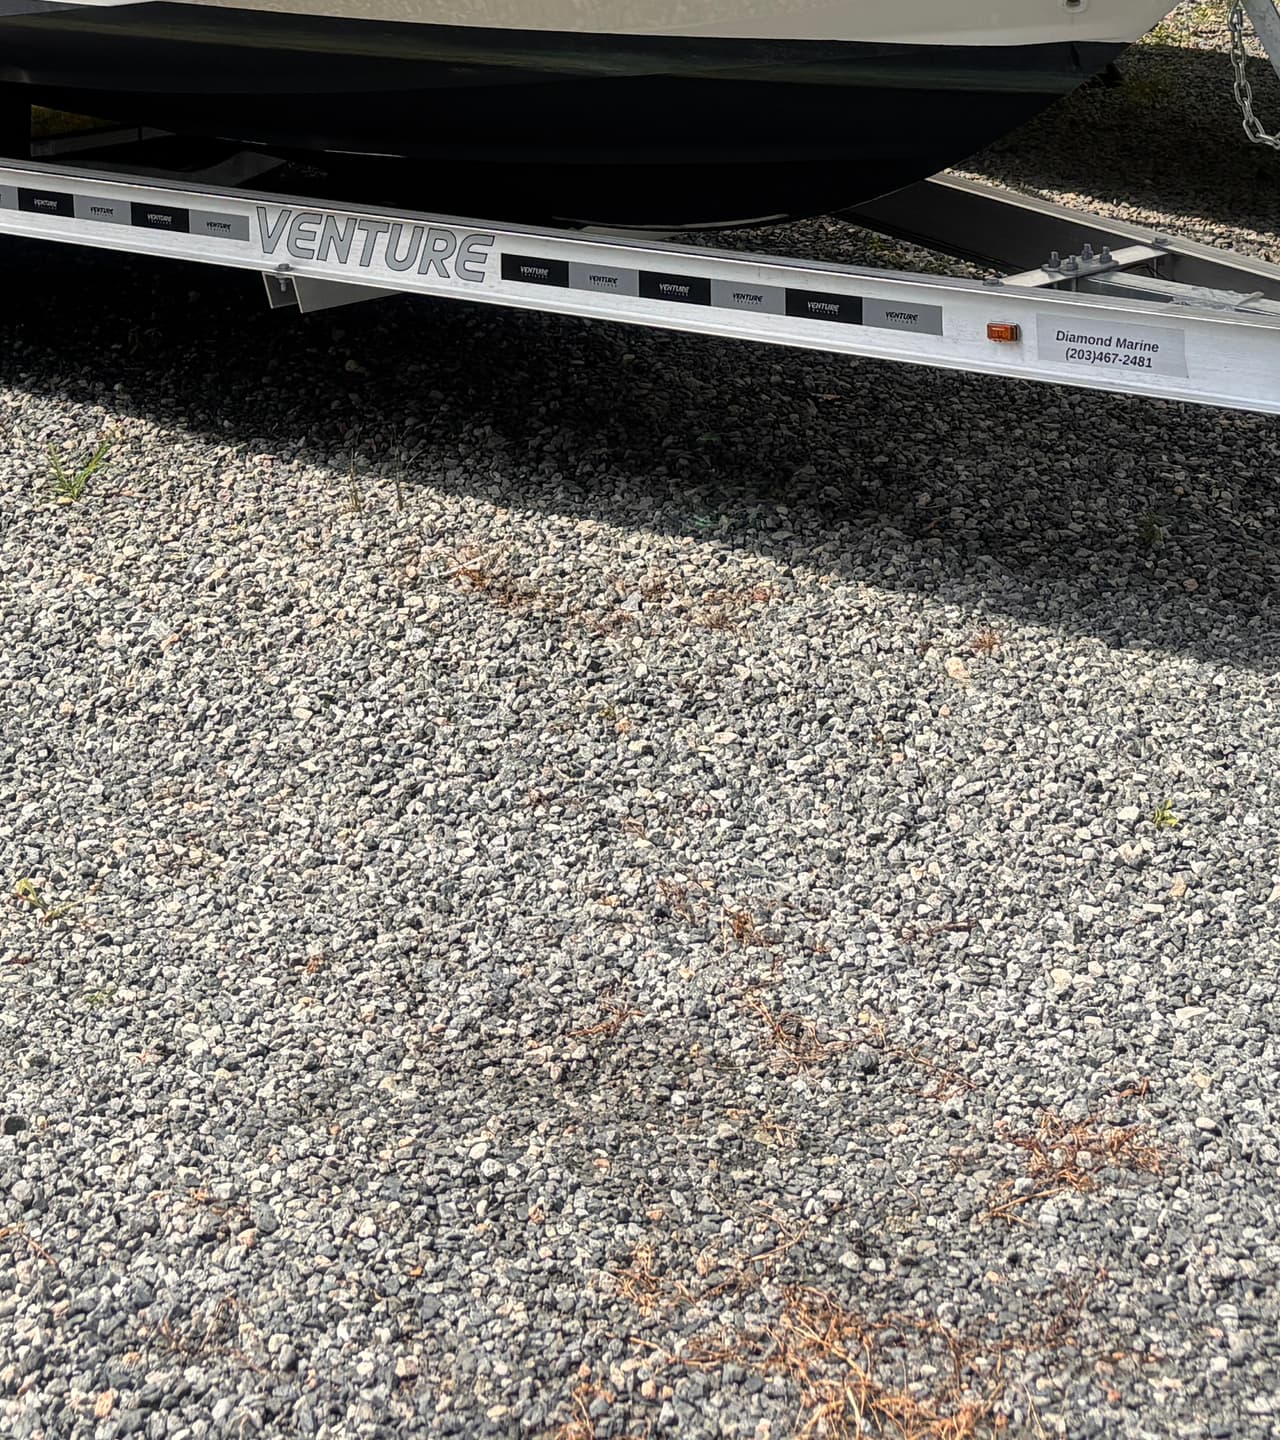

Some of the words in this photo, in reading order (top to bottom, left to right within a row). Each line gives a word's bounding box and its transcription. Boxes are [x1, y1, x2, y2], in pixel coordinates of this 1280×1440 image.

[256, 206, 496, 283] VENTURE
[659, 283, 691, 294] VENTURE
[732, 293, 764, 303] VENTURE
[807, 301, 840, 312] VENTURE
[1055, 330, 1113, 347] Diamond
[1115, 337, 1160, 353] Marine
[1065, 347, 1153, 368] (203)467-2481
